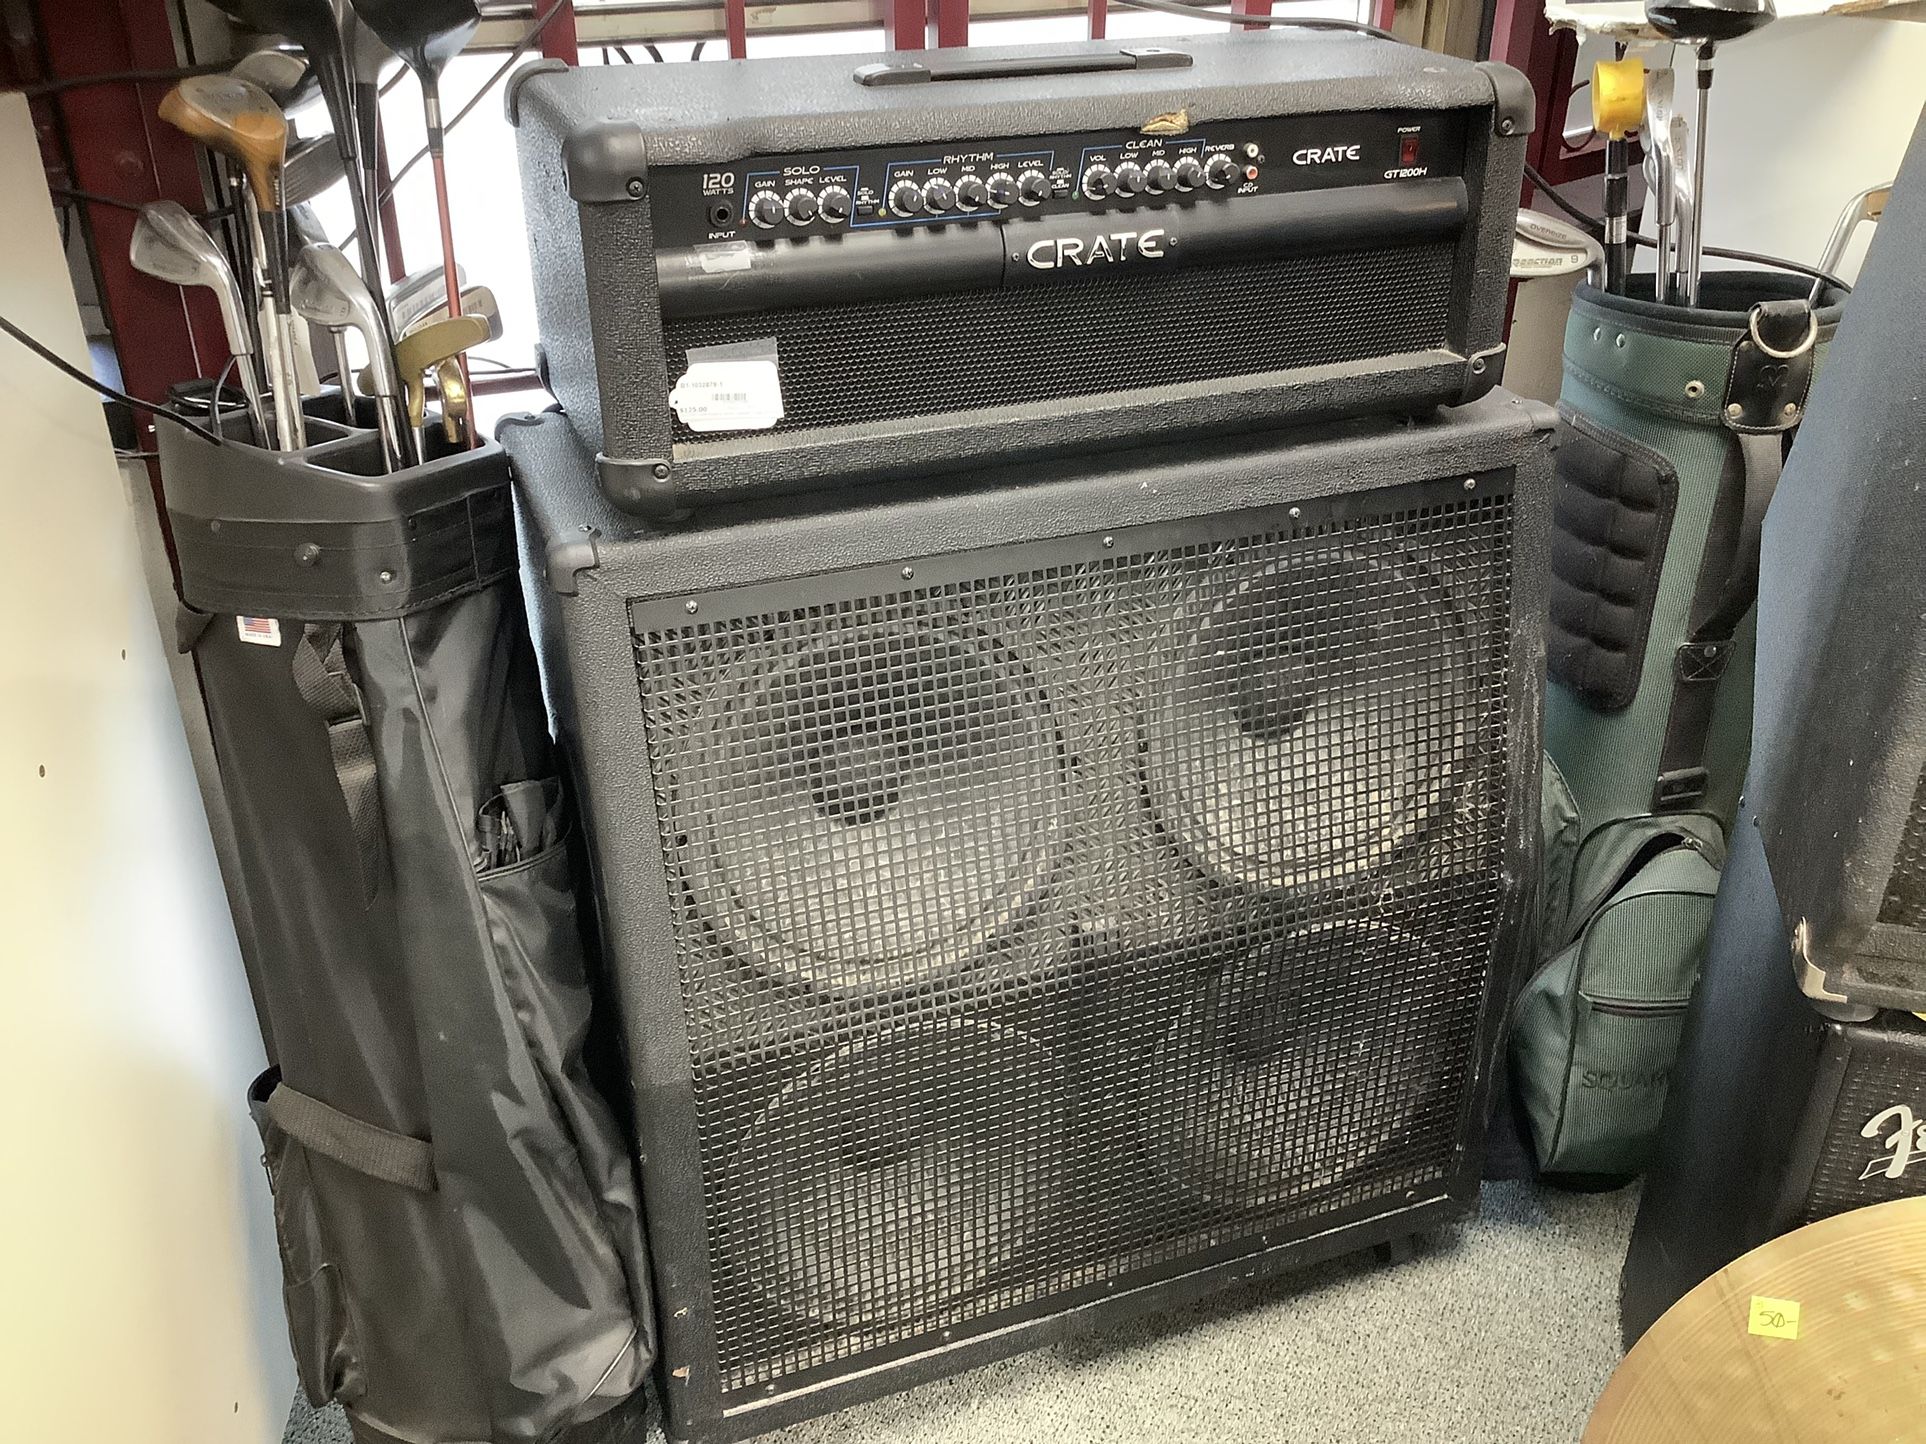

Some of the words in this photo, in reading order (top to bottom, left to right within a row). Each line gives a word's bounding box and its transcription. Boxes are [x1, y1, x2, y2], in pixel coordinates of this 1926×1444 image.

[1397, 125, 1421, 133] POWER
[1125, 139, 1163, 150] CLEAN
[1205, 143, 1235, 152] REVERB
[943, 152, 994, 164] RHYTHM
[1090, 154, 1107, 162] VOL
[1119, 152, 1139, 160] LOW
[1152, 149, 1166, 157] MID
[1179, 146, 1197, 155] HIGH
[1292, 144, 1361, 166] CRATE
[782, 165, 821, 176] SOLO
[894, 169, 914, 178] GAIN
[927, 167, 948, 176] LOW
[961, 164, 976, 172] MID
[990, 162, 1010, 170] HIGH
[1017, 159, 1044, 168] LEVEL
[1383, 167, 1428, 179] GT1200H
[702, 172, 735, 189] 120
[755, 180, 776, 188] GAIN
[784, 177, 814, 186] SHAPE
[819, 175, 847, 184] LEVEL
[703, 187, 735, 196] WATTS
[1237, 185, 1259, 194] INPUT
[708, 231, 736, 239] INPUT
[1026, 229, 1165, 270] CRATE
